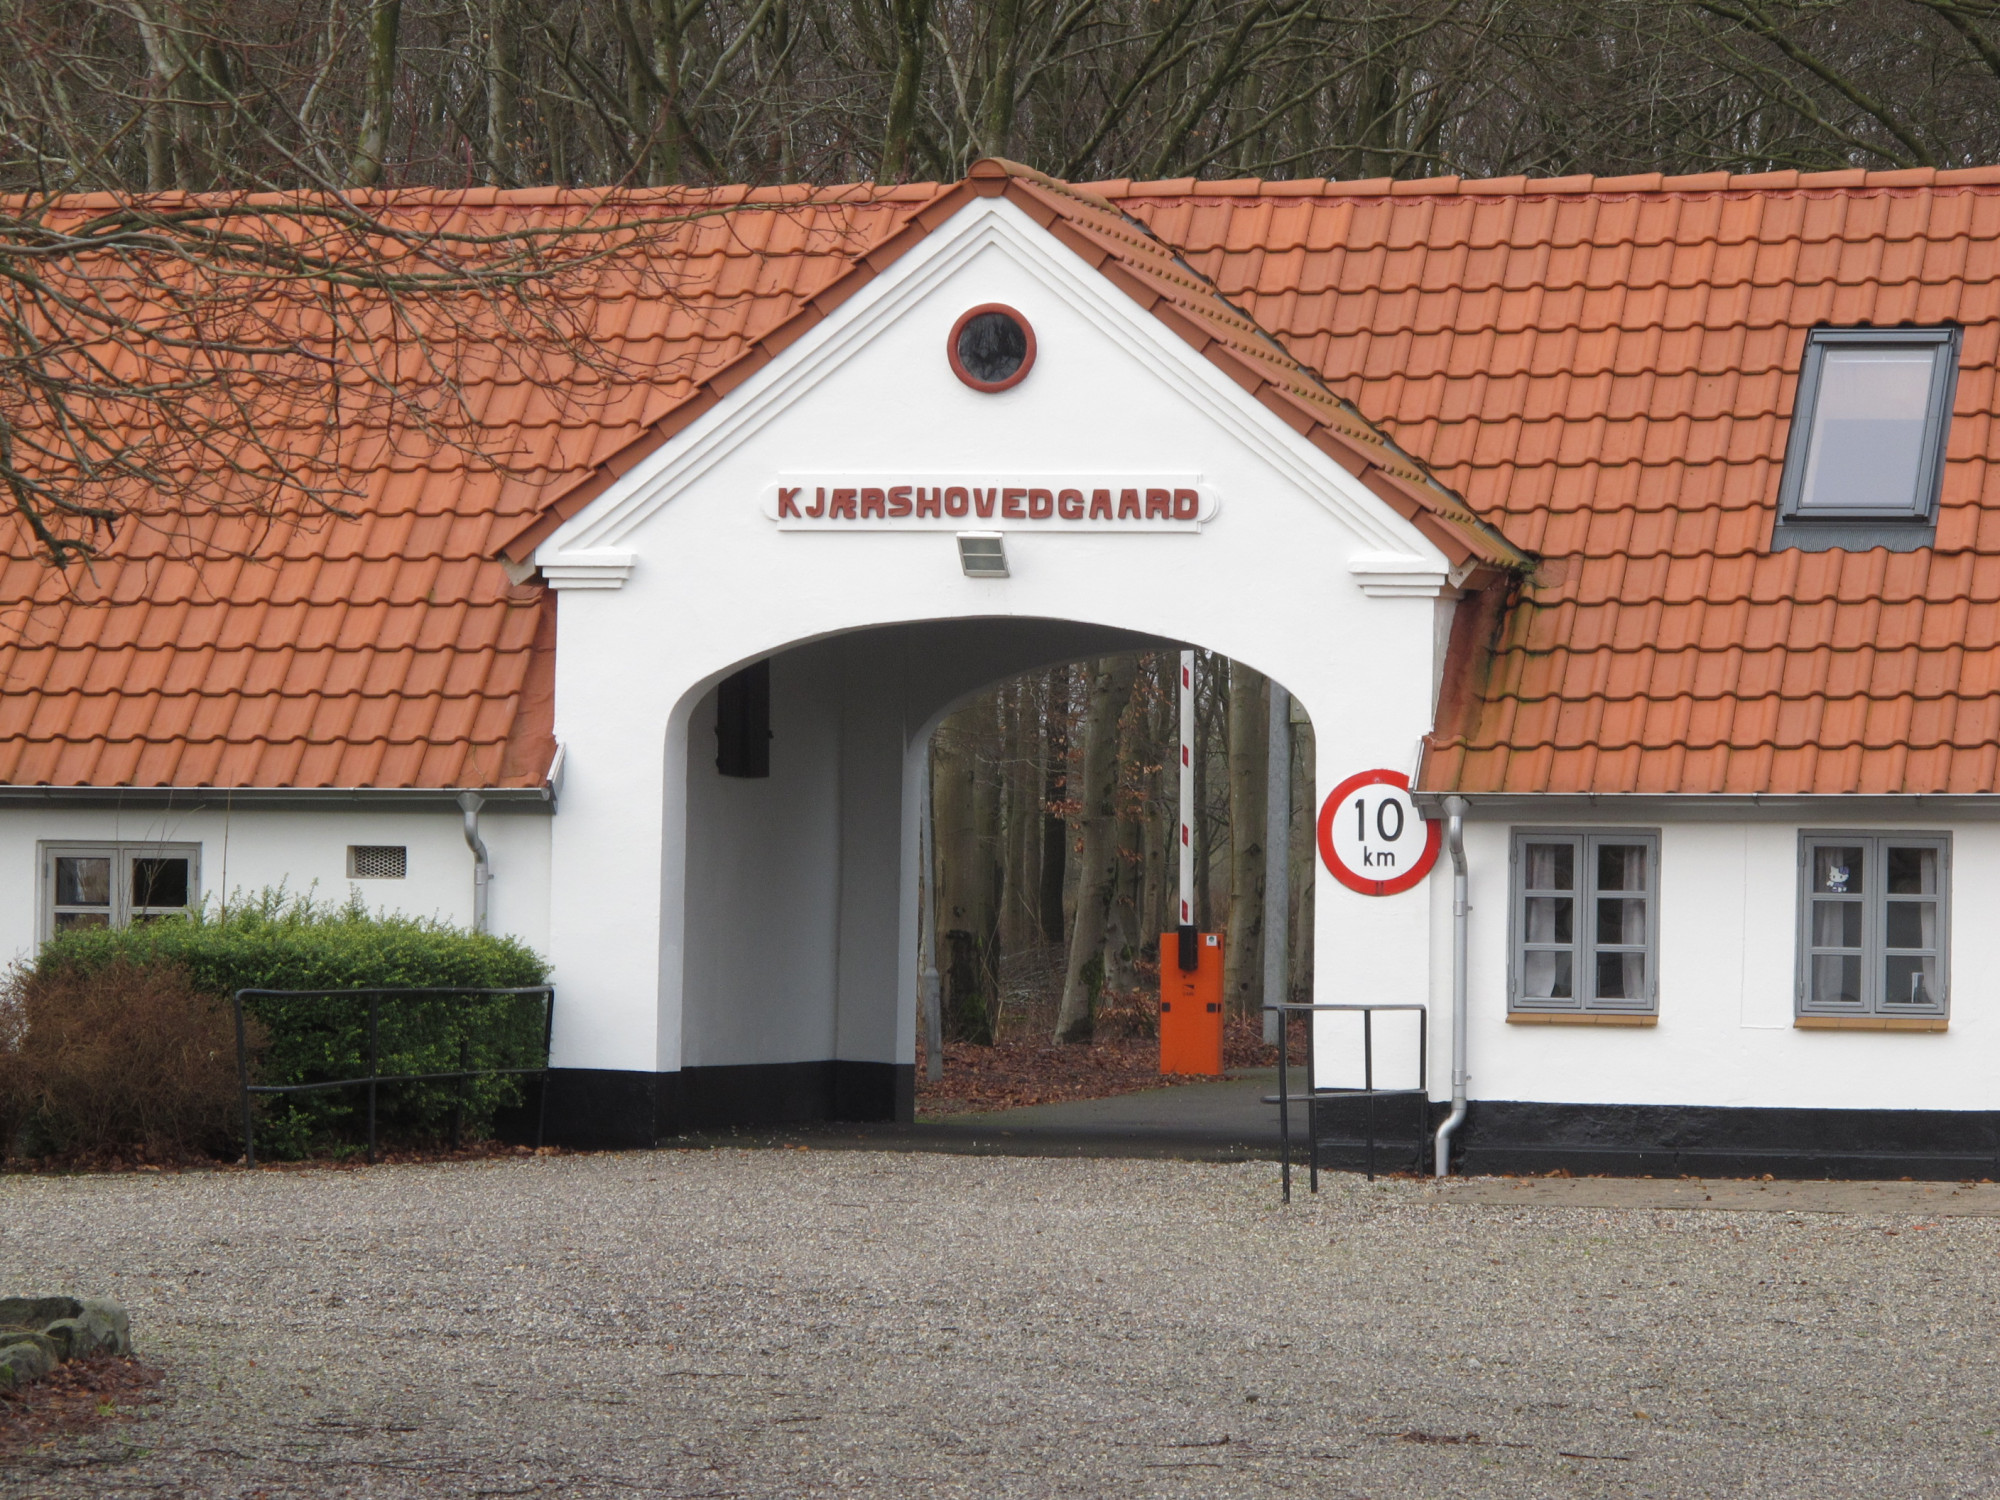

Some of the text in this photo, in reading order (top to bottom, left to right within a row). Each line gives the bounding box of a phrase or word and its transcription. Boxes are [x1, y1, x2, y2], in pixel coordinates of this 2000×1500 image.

[778, 485, 1199, 520] KJÆRSHOVEDGAARD
[1355, 798, 1404, 842] 10
[1363, 845, 1396, 867] km
